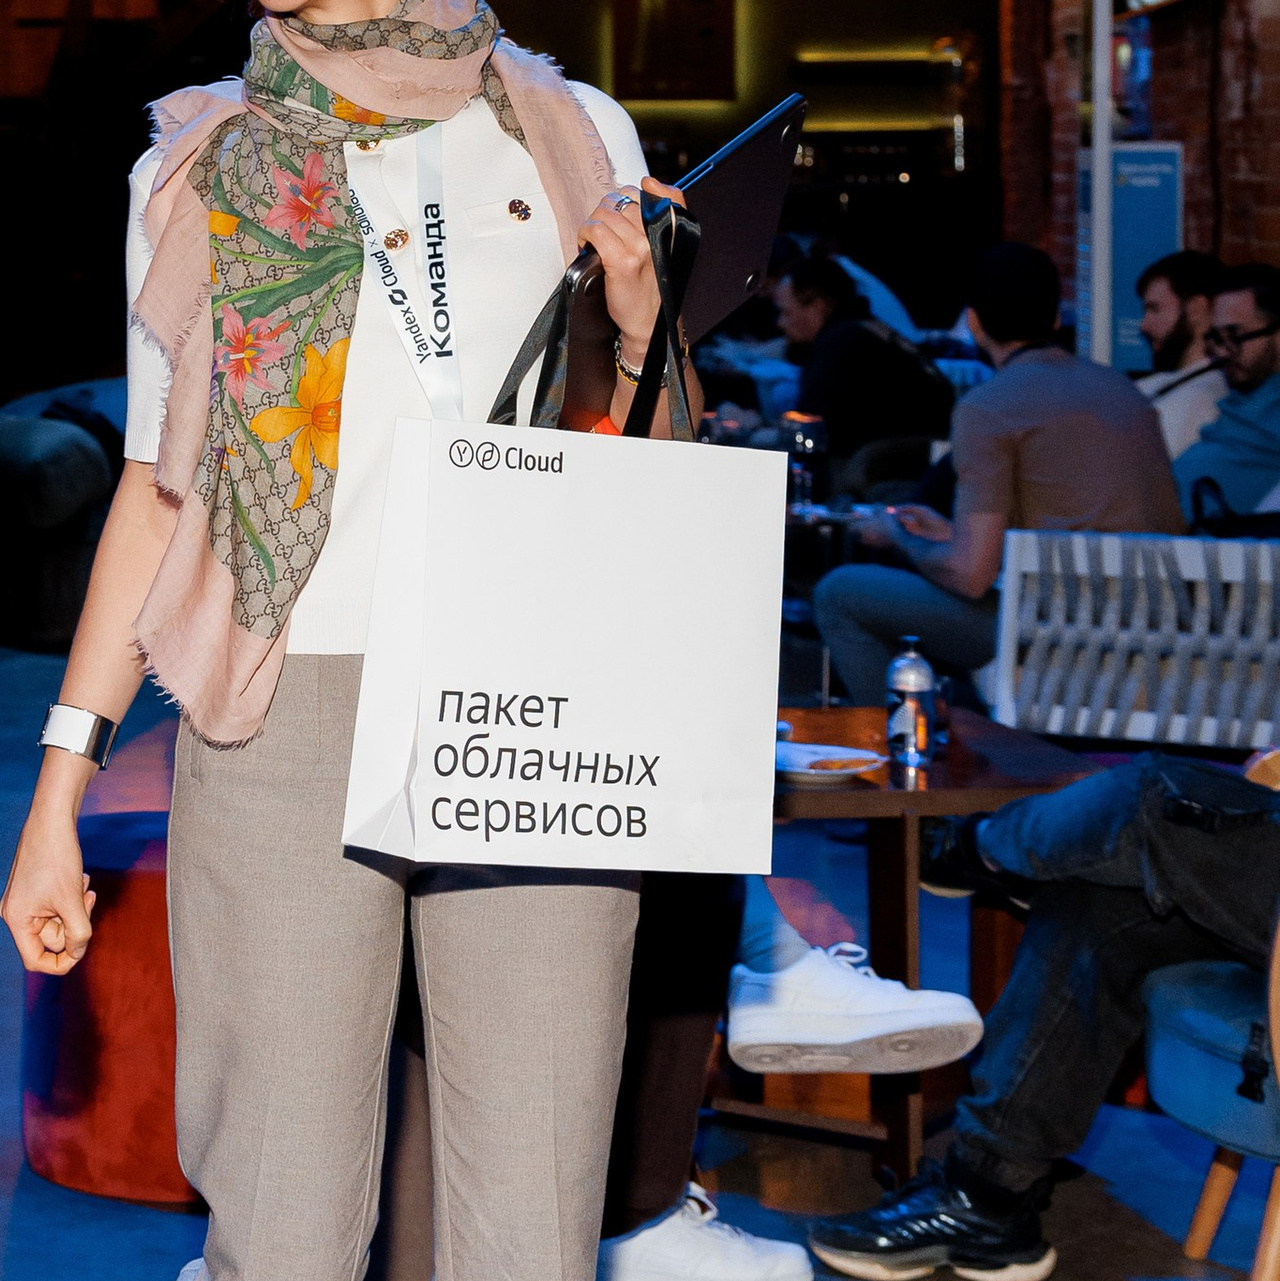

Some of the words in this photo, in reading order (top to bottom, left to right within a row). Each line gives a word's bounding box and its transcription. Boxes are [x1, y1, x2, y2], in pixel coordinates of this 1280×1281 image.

[370, 250, 399, 287] Cloud
[424, 203, 453, 358] Команда
[401, 306, 432, 363] Yandex
[505, 447, 563, 473] Cloud
[437, 689, 569, 728] пакет
[433, 733, 661, 787] облачных
[431, 795, 648, 842] сервисов
